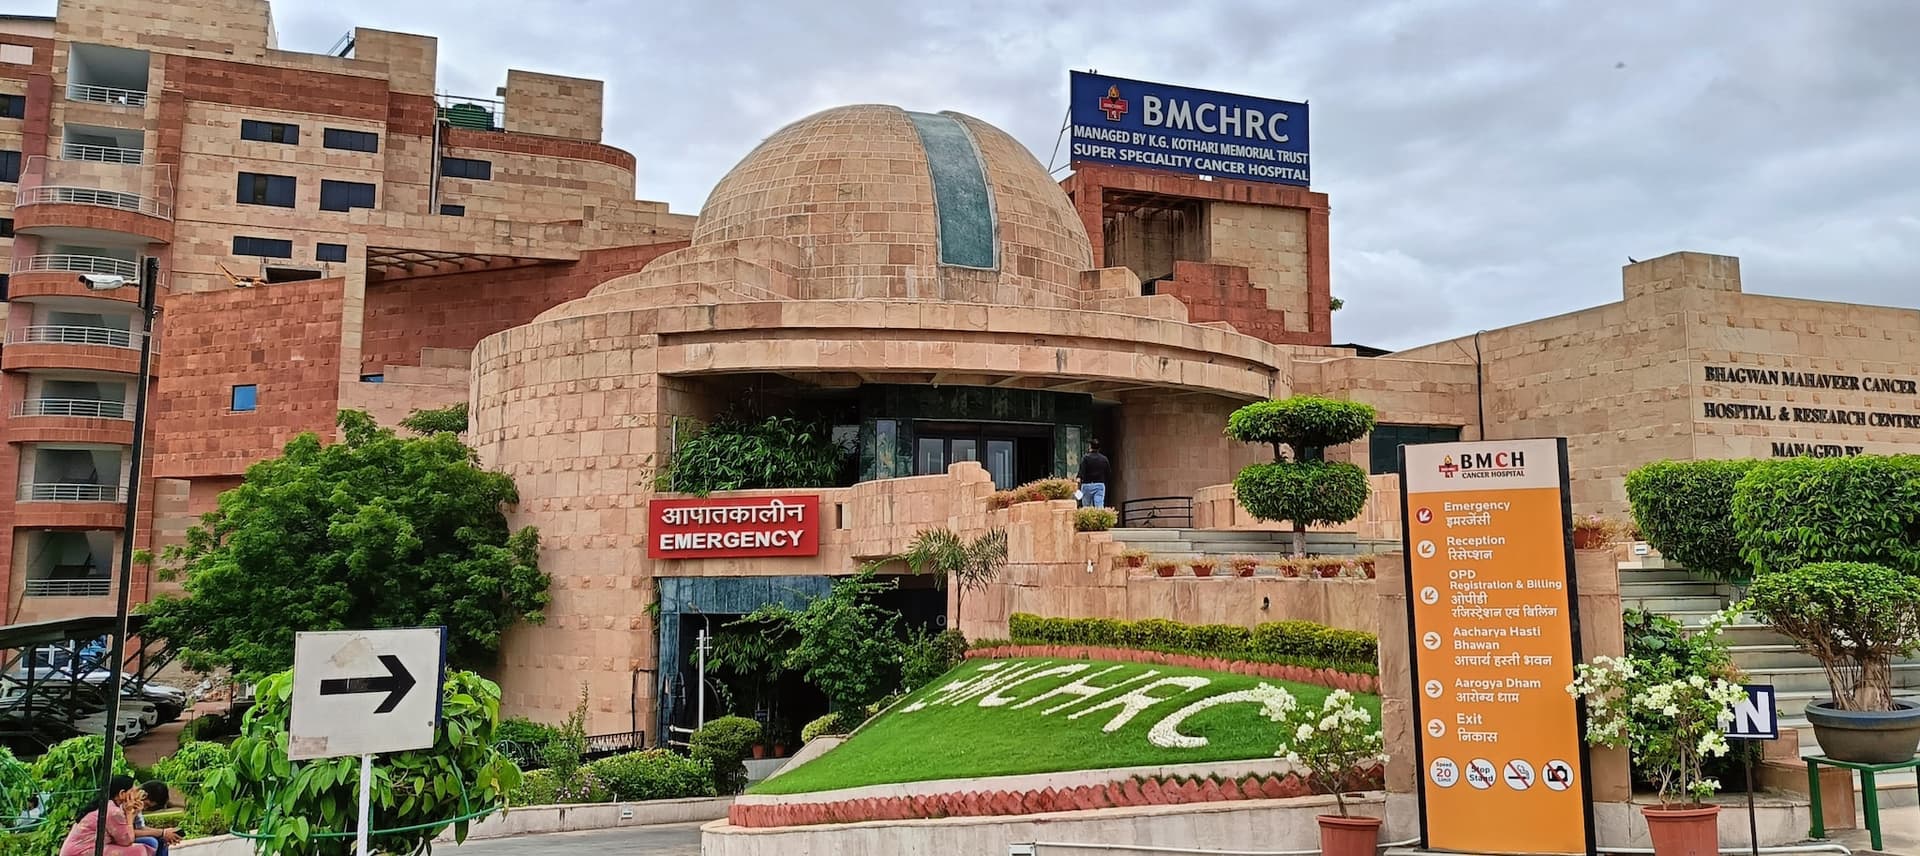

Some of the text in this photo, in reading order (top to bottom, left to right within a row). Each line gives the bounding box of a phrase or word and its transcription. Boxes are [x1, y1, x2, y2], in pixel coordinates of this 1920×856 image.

[1143, 95, 1290, 142] BMCHRC
[1073, 125, 1309, 164] MANAGED BY K.G. KOTHARI MEMORIAL TRUST
[1073, 143, 1309, 182] SUPER SPECIALITY CANCER HOSPITAL
[1704, 366, 1917, 395] BHAGWAN MAHAVEER CANCER
[1704, 403, 1920, 429] HOSPITAL & RESEARCH CENTRE
[1771, 442, 1843, 458] MANAGED
[1461, 452, 1524, 469] BMCH
[1462, 470, 1525, 479] CANCER HOSPITAL
[661, 499, 806, 525] आपातकालीन
[1444, 501, 1511, 513] Emergency
[659, 529, 804, 550] EMERGENCY
[1446, 536, 1506, 547] Reception
[1448, 547, 1494, 561] रिसेप्शन
[1449, 569, 1477, 580] OPD
[1450, 579, 1563, 592] Registration & Billing
[1451, 592, 1489, 605] ओपीडी
[1453, 626, 1542, 639] Aacharya Hasti
[1454, 640, 1501, 651] Bhawan
[1454, 651, 1552, 667] आचार्य हस्ती भवन
[1455, 678, 1542, 690] Aarogya Dham
[1456, 713, 1483, 726] Exit
[1457, 729, 1499, 743] निकास
[1436, 767, 1452, 778] 20
